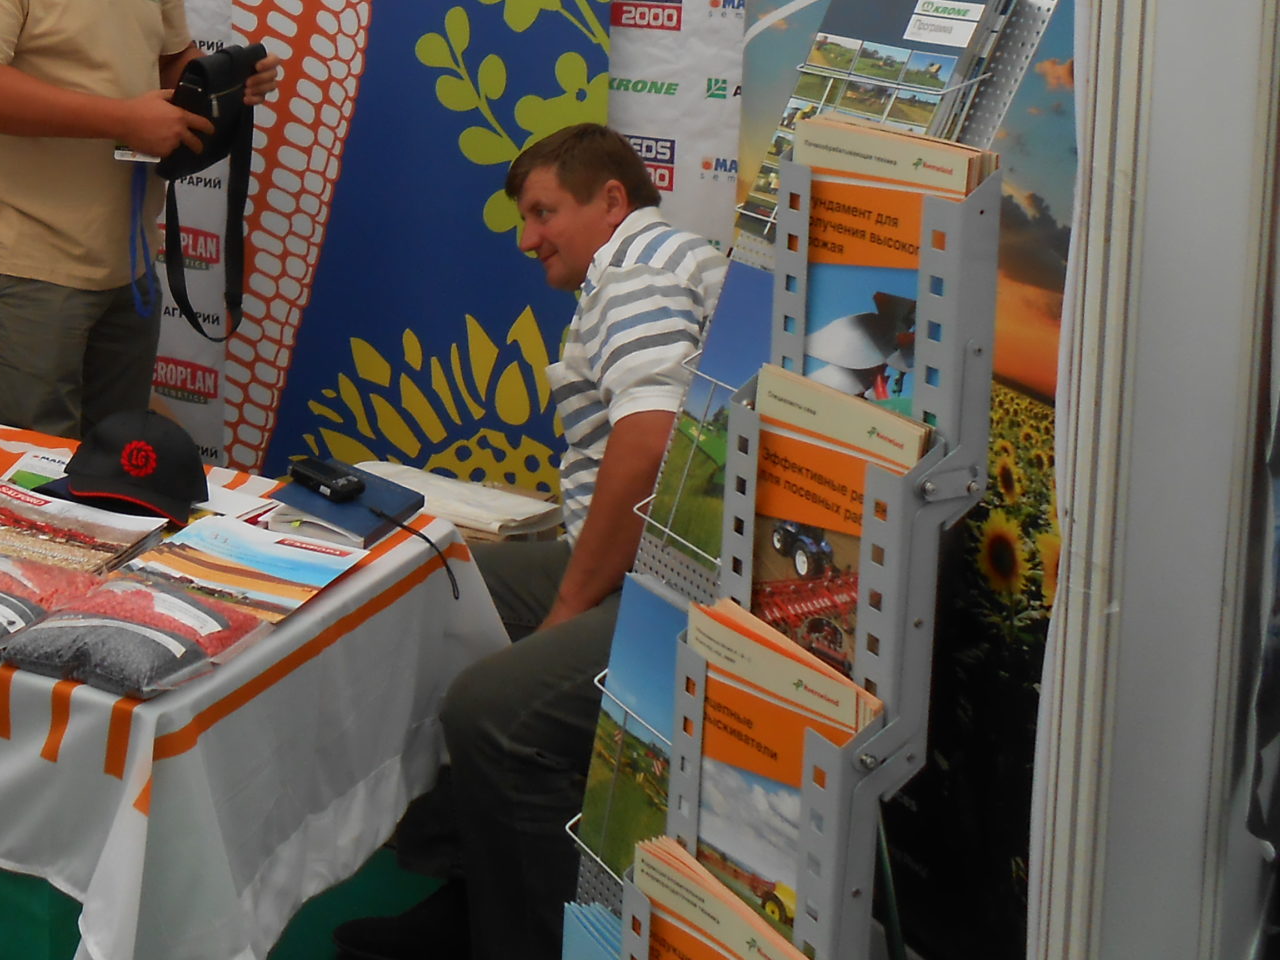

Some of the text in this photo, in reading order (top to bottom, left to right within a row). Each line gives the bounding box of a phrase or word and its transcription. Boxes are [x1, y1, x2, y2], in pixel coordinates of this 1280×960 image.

[622, 6, 677, 27] 2000
[933, 6, 970, 16] KRONE
[875, 213, 899, 228] для
[0, 486, 45, 505] SALFORD
